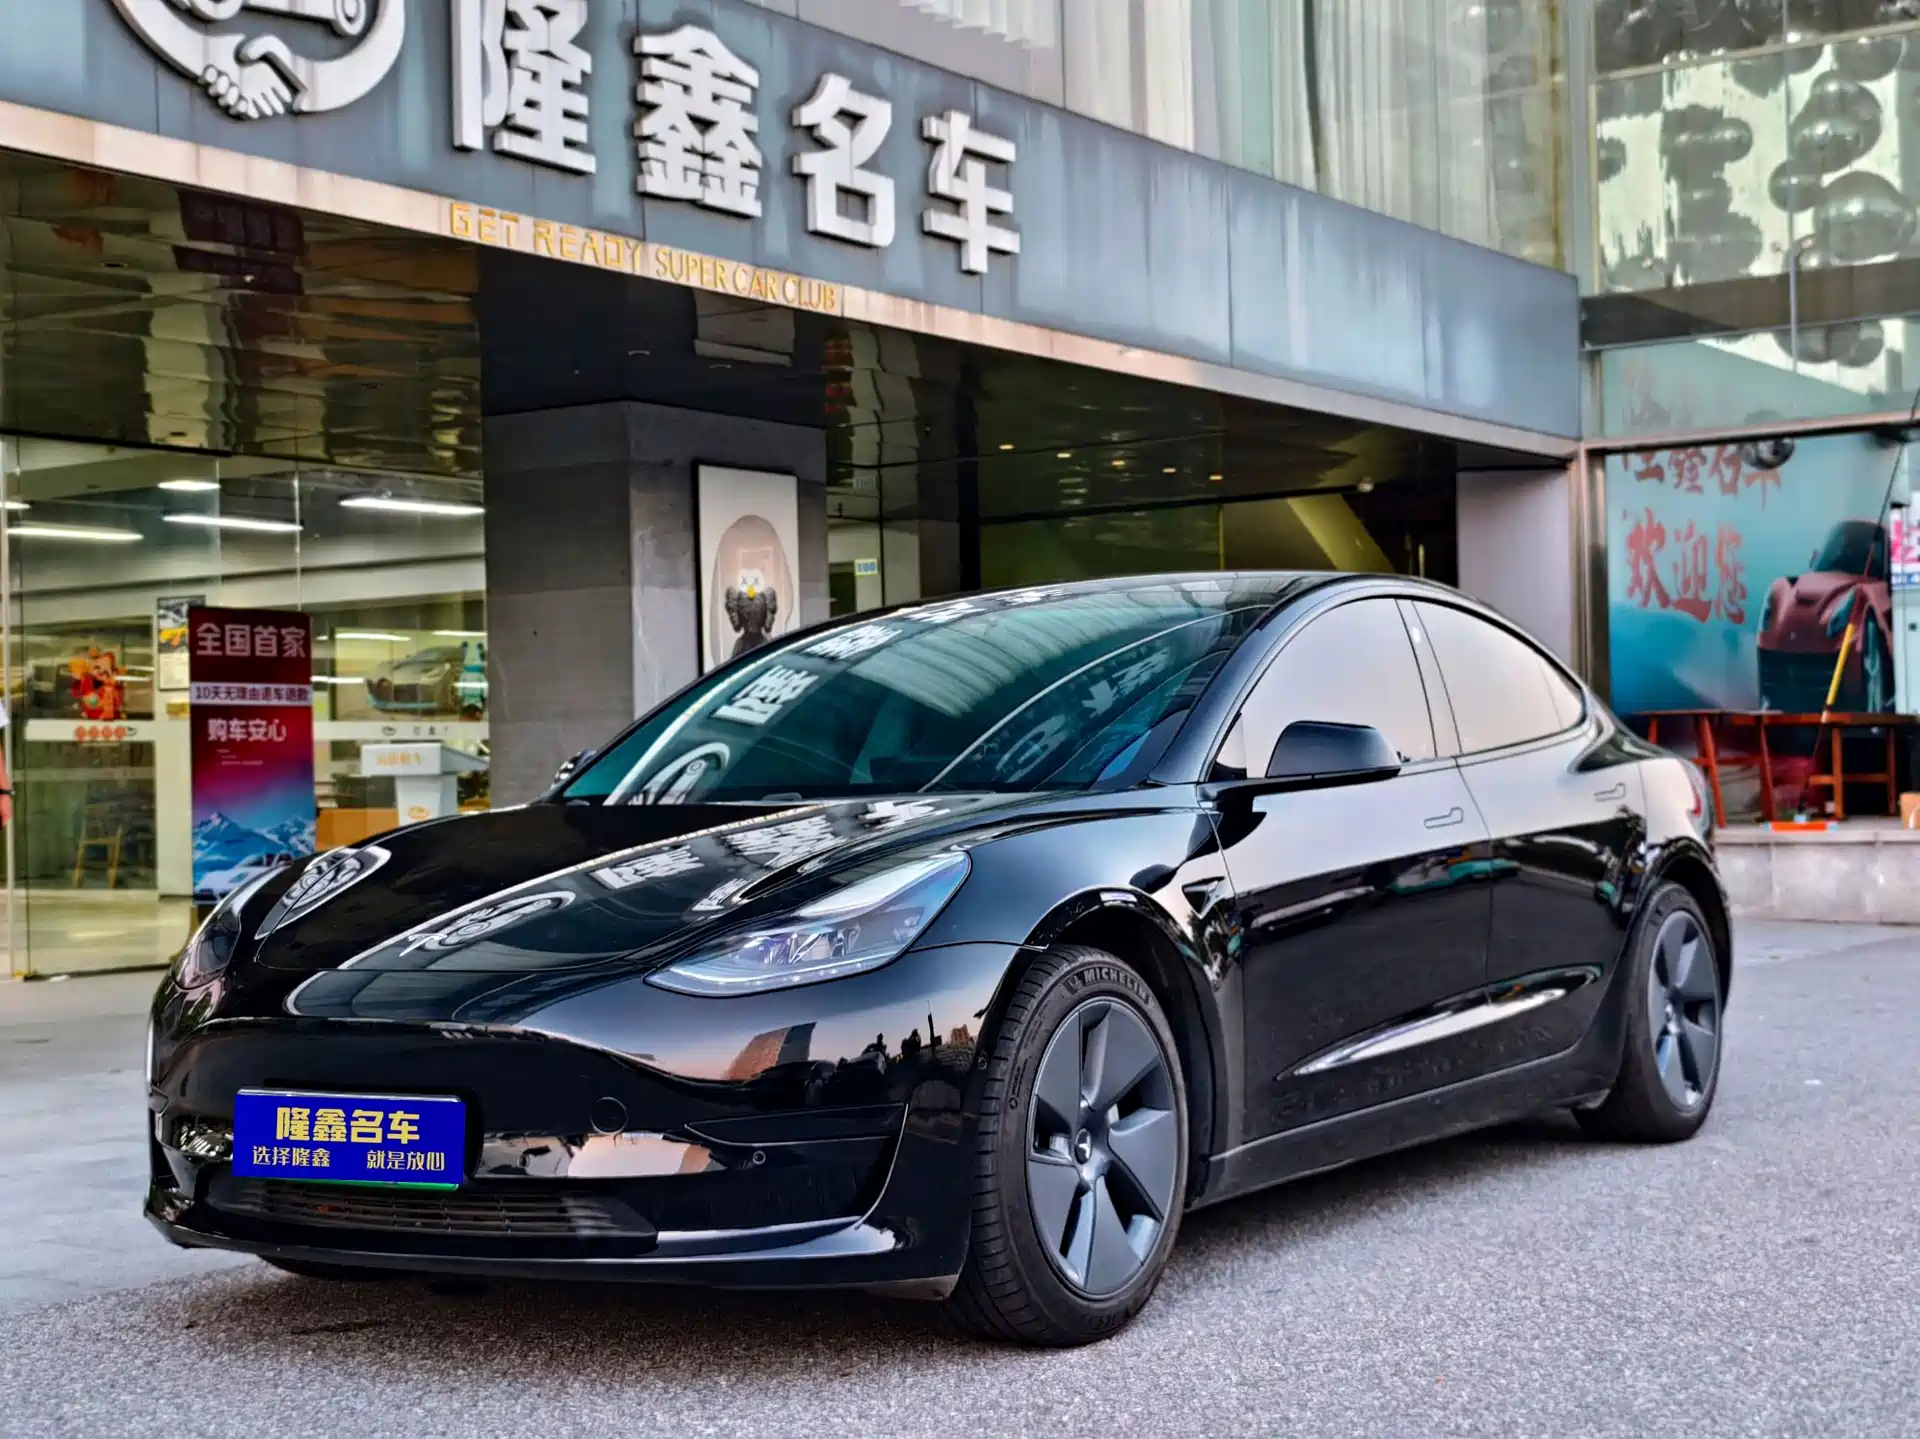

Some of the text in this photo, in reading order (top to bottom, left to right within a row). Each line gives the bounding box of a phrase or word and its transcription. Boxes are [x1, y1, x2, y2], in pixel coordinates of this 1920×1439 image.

[452, 0, 1020, 274] 隆鑫名车
[451, 202, 836, 311] GET READY SUPER CAR CLUB
[1626, 507, 1747, 625] 欢迎您
[196, 622, 306, 658] 全国首家
[208, 718, 287, 742] 购车安心
[1083, 966, 1148, 1001] MICHELIN
[276, 1107, 420, 1144] 隆鑫名车
[252, 1145, 445, 1171] 选择隆鑫 就是放心
